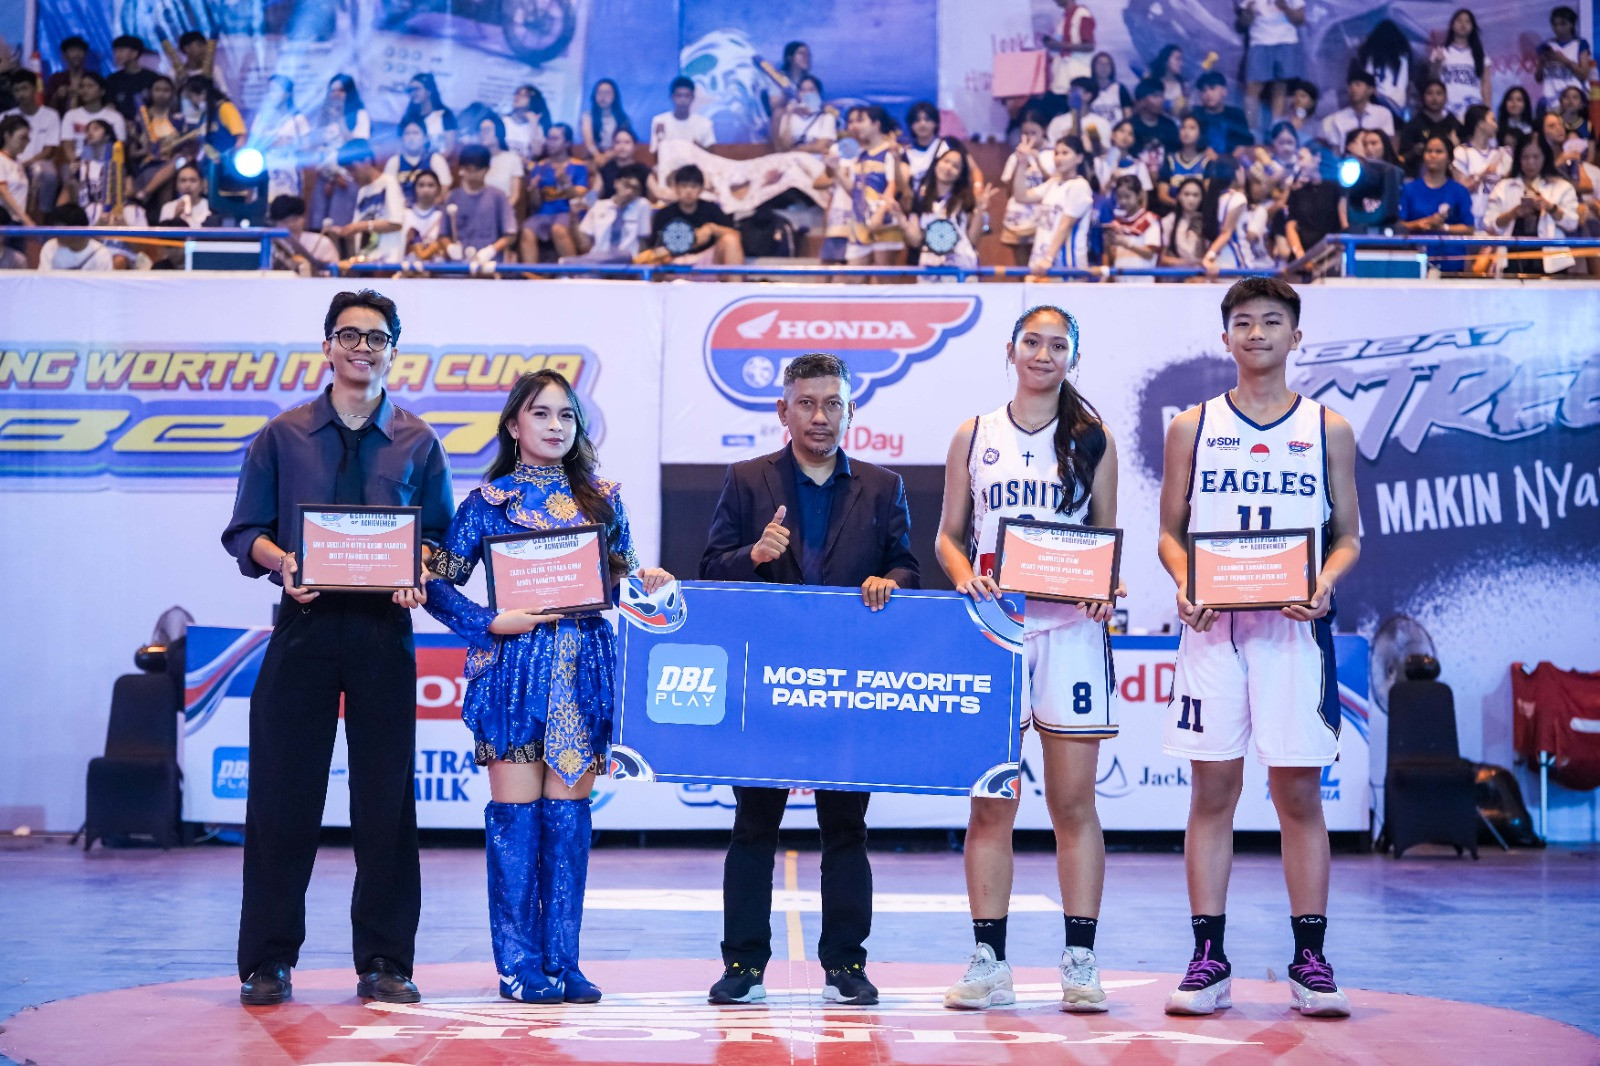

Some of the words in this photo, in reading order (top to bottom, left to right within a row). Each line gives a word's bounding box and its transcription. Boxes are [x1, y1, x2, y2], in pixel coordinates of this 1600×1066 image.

[777, 320, 916, 340] HONDA
[0, 351, 78, 389] NG
[86, 351, 278, 390] WORTH
[281, 352, 333, 391] IT
[434, 354, 584, 392] CUMA
[855, 427, 903, 457] Day
[1217, 437, 1240, 446] SDH
[1200, 468, 1317, 497] EAGLES
[982, 479, 1072, 517] OSNIT
[1376, 472, 1502, 535] MAKIN
[1513, 459, 1600, 530] NYa
[656, 665, 717, 693] DBL
[763, 666, 847, 687] MOST
[856, 670, 992, 693] FAVORITE
[655, 692, 714, 707] PLAY
[772, 688, 981, 714] PARTICIPANTS
[1073, 682, 1092, 714] 8
[1177, 695, 1204, 733] 11
[217, 760, 248, 779] DB
[415, 750, 479, 774] TRA
[216, 778, 248, 789] PLA
[1139, 766, 1190, 786] Jack
[327, 1024, 1264, 1045] HONDA
